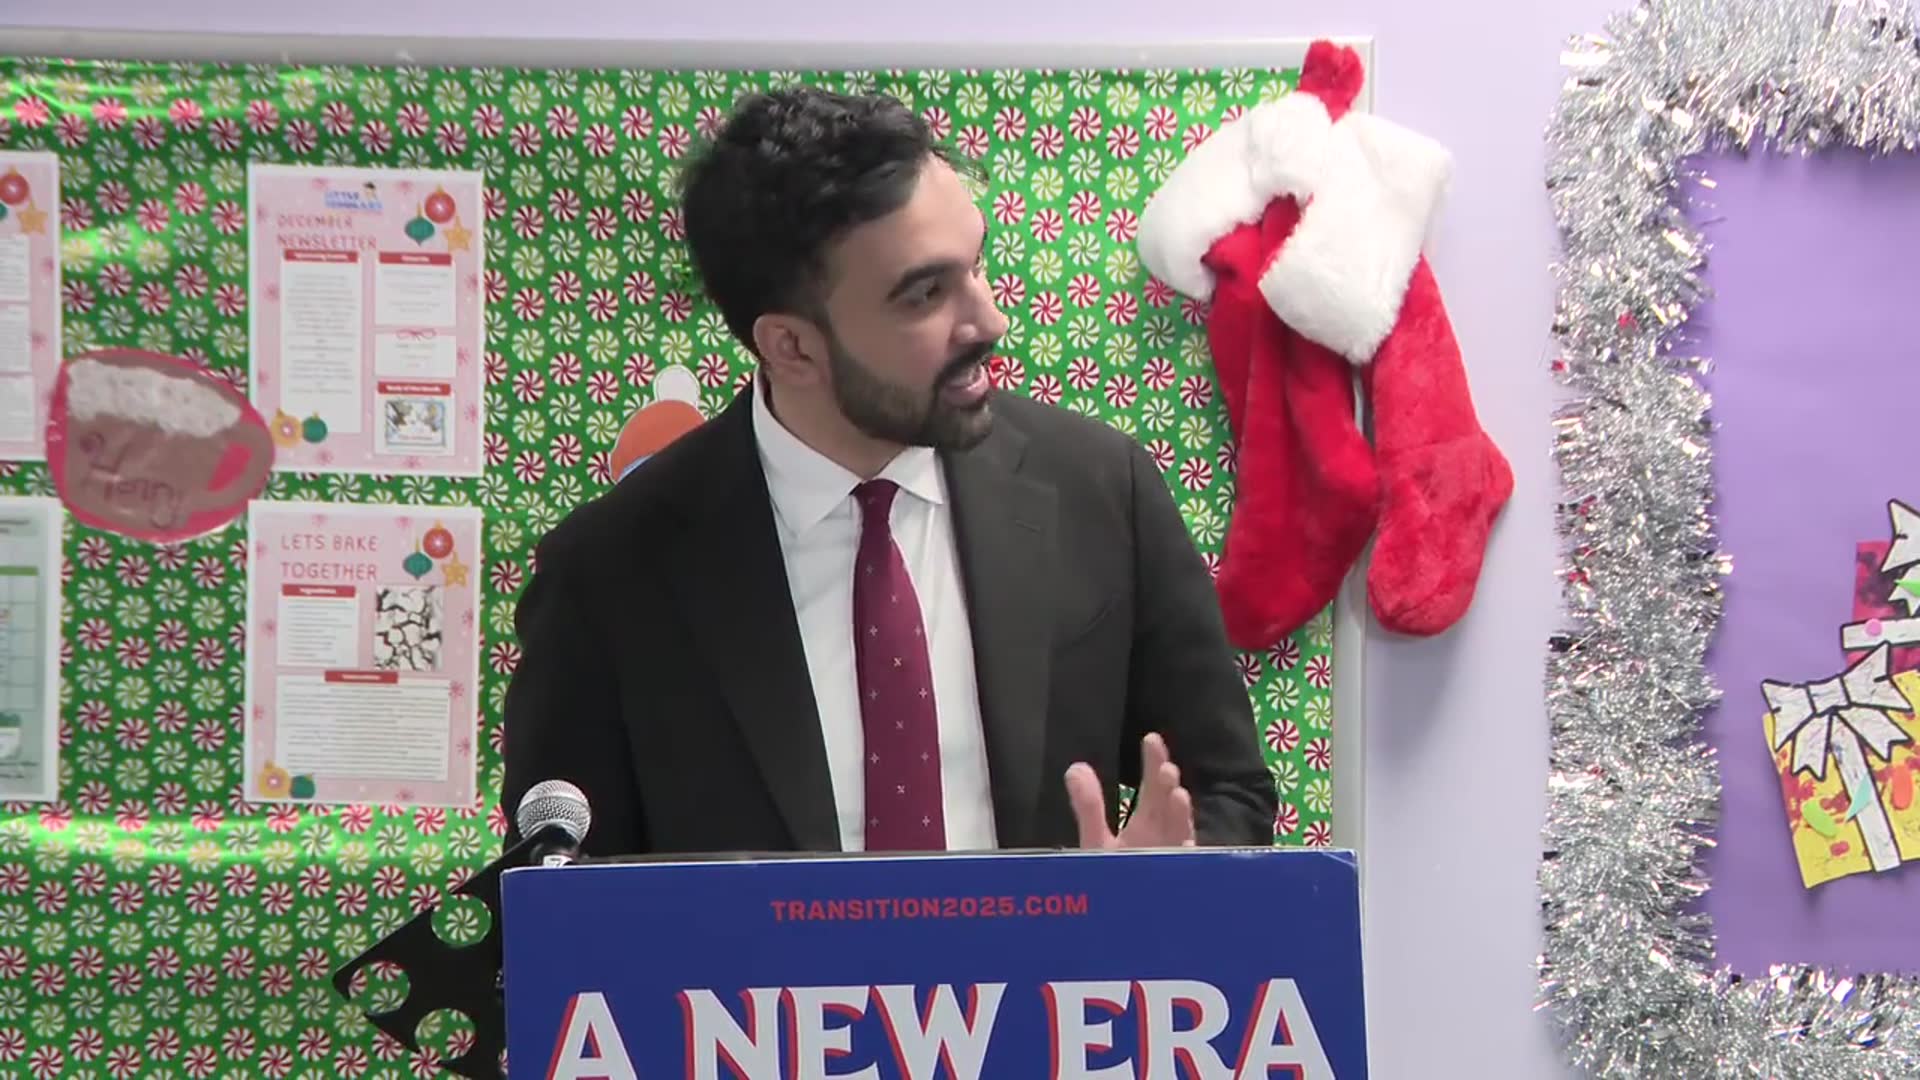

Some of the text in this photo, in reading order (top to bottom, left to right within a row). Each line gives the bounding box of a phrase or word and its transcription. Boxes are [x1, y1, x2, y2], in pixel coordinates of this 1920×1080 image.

[277, 214, 353, 229] DECEMBER
[277, 233, 377, 250] NEWSLETTER
[281, 534, 378, 551] LETS BAKE
[281, 562, 378, 580] TOGETHER
[771, 894, 1088, 921] TRANSITION2025.COM
[546, 977, 1336, 1080] A NEW ERA
